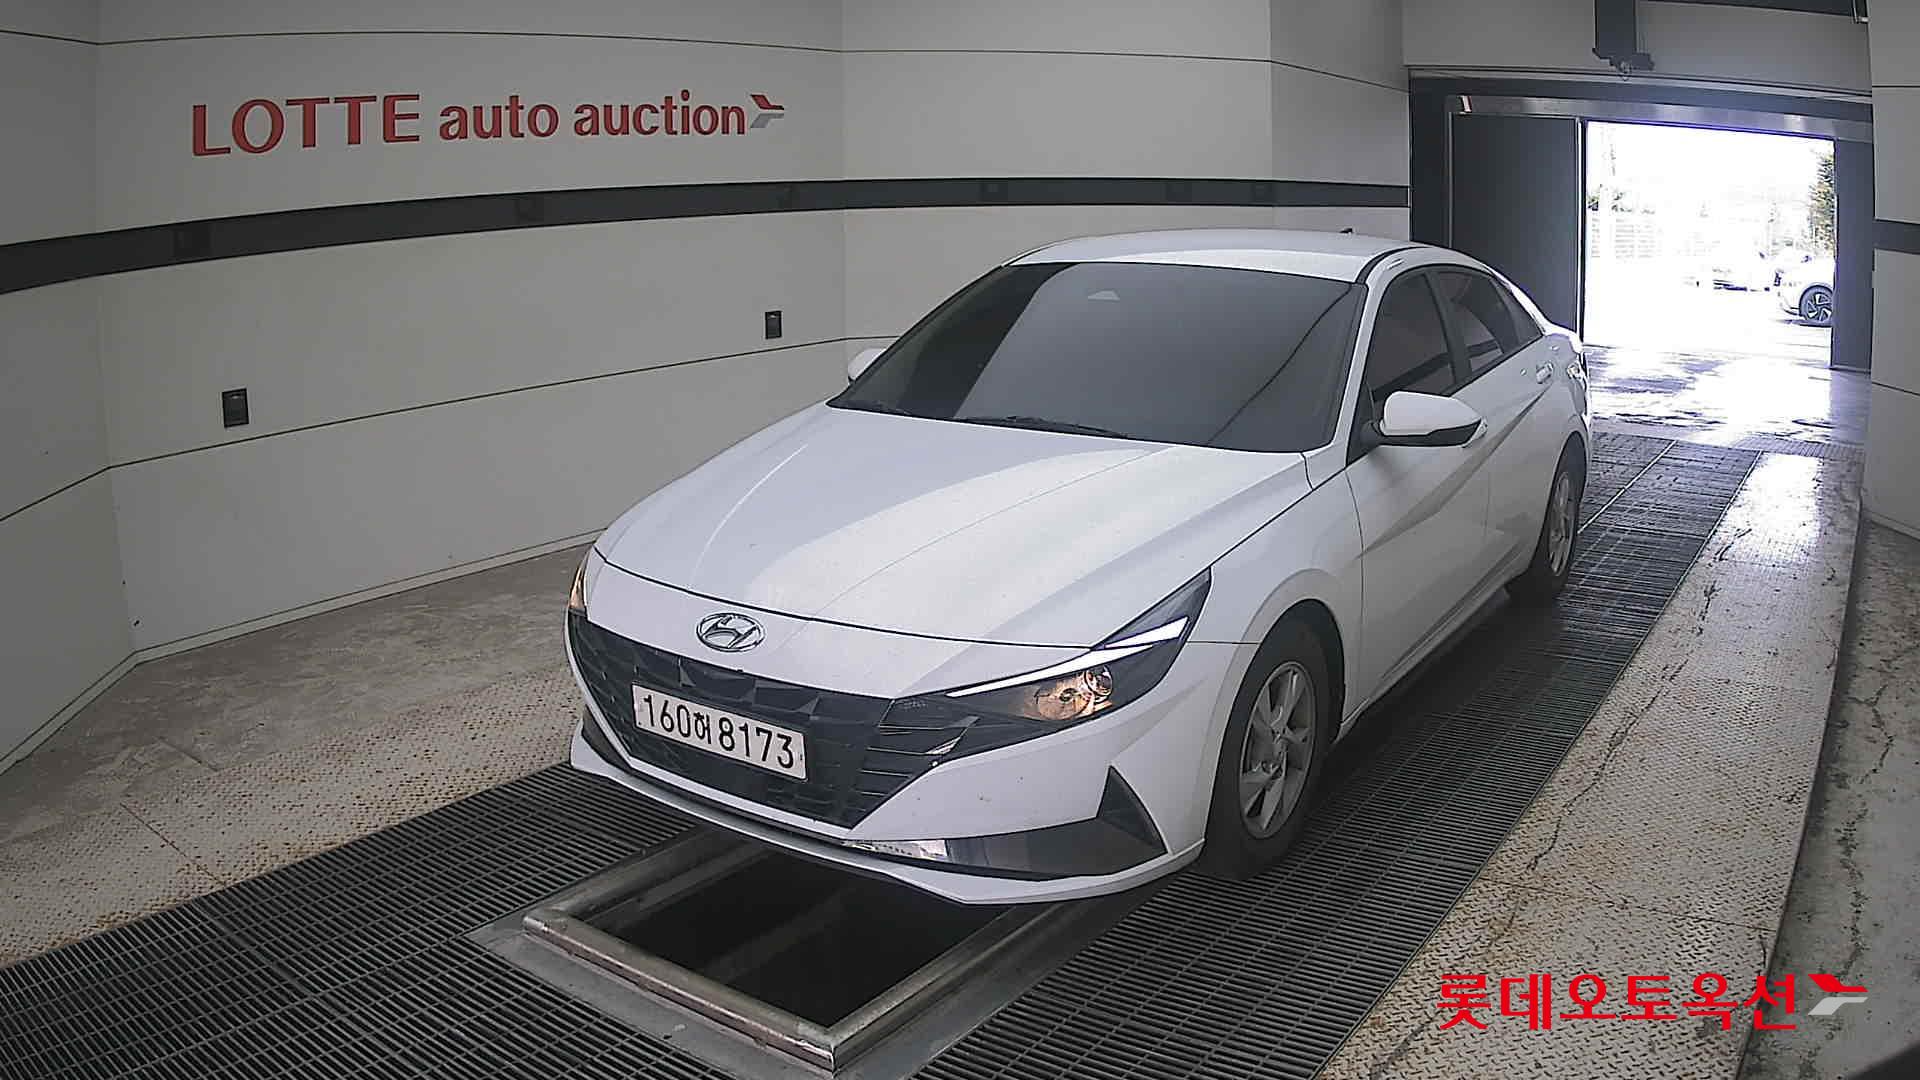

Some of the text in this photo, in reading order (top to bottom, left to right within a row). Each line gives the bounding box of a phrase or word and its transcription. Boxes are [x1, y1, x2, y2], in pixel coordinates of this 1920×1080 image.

[191, 89, 747, 156] LOTTE auto auction
